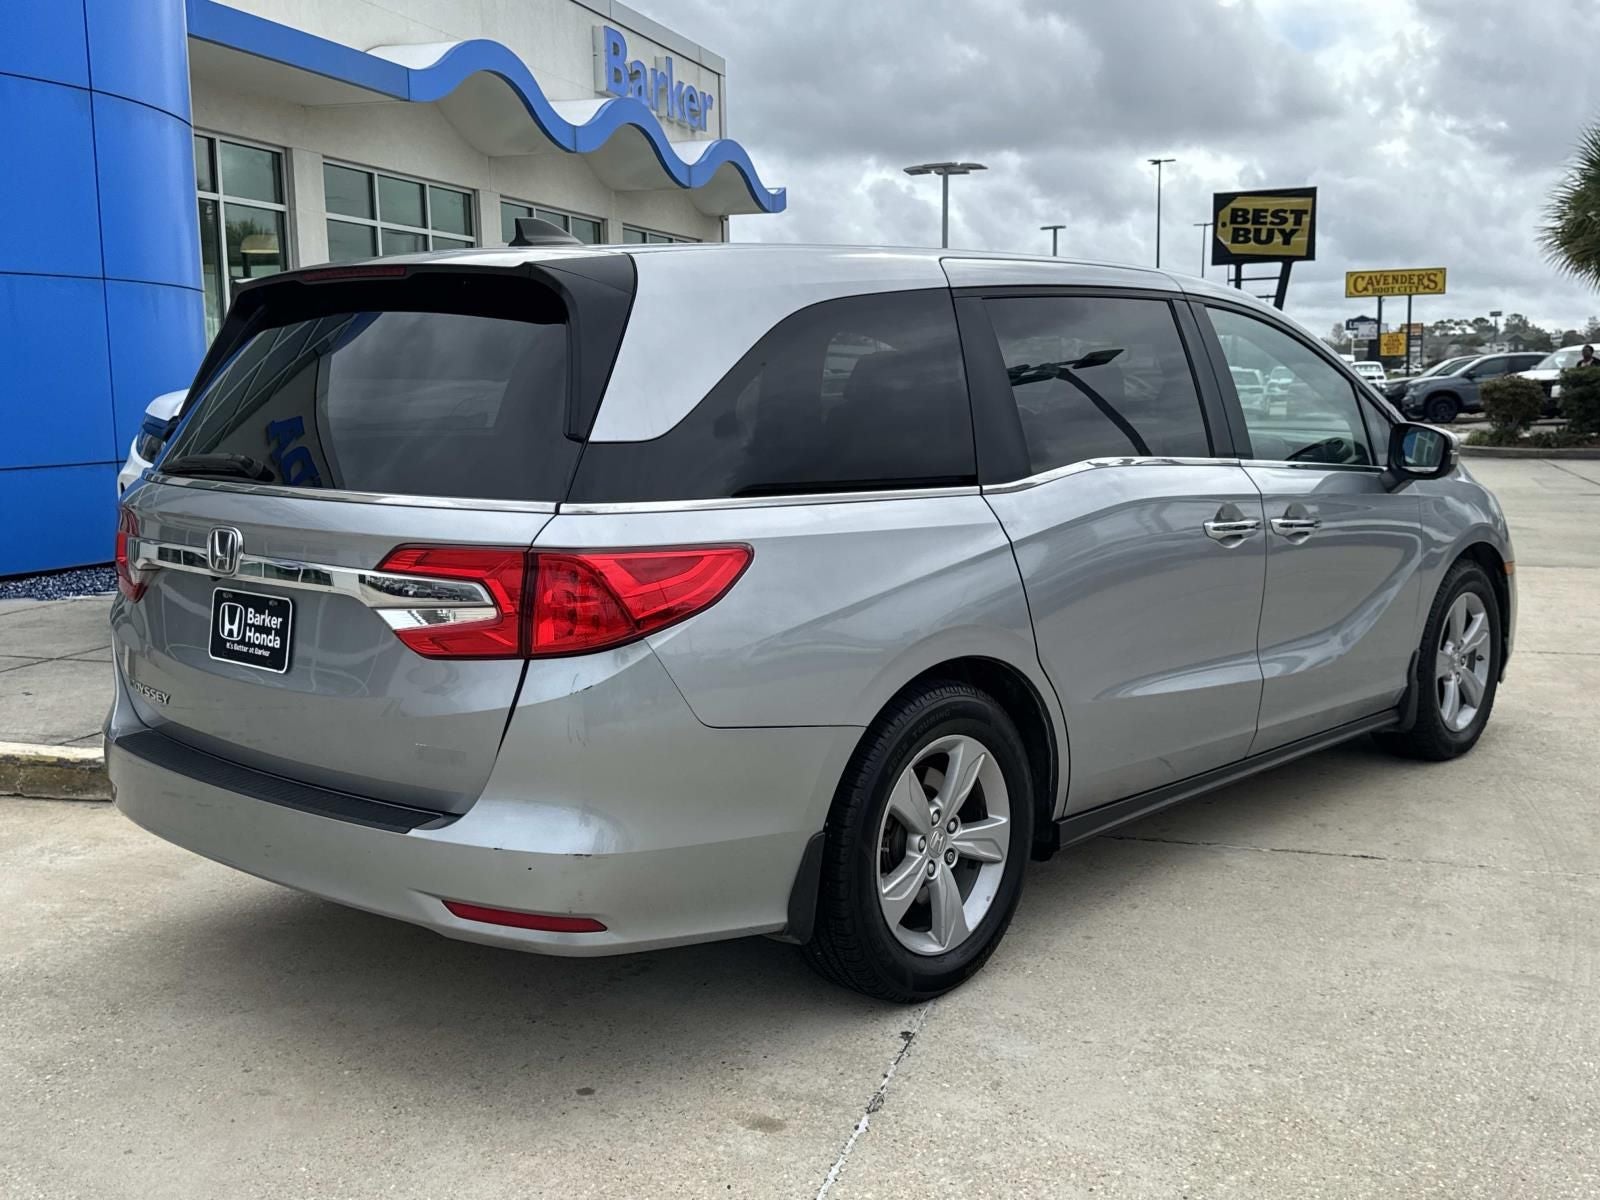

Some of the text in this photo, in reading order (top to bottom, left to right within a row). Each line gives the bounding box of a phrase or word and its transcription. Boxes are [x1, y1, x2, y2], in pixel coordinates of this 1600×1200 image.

[603, 25, 714, 132] Barker
[1229, 208, 1309, 227] BEST
[1230, 227, 1300, 246] BUY
[1353, 272, 1438, 294] CAVENDER'S
[1372, 285, 1420, 294] BOOT CITY
[247, 607, 283, 629] Barker
[245, 626, 281, 648] Honda
[234, 643, 249, 653] Better
[254, 647, 271, 657] Barker
